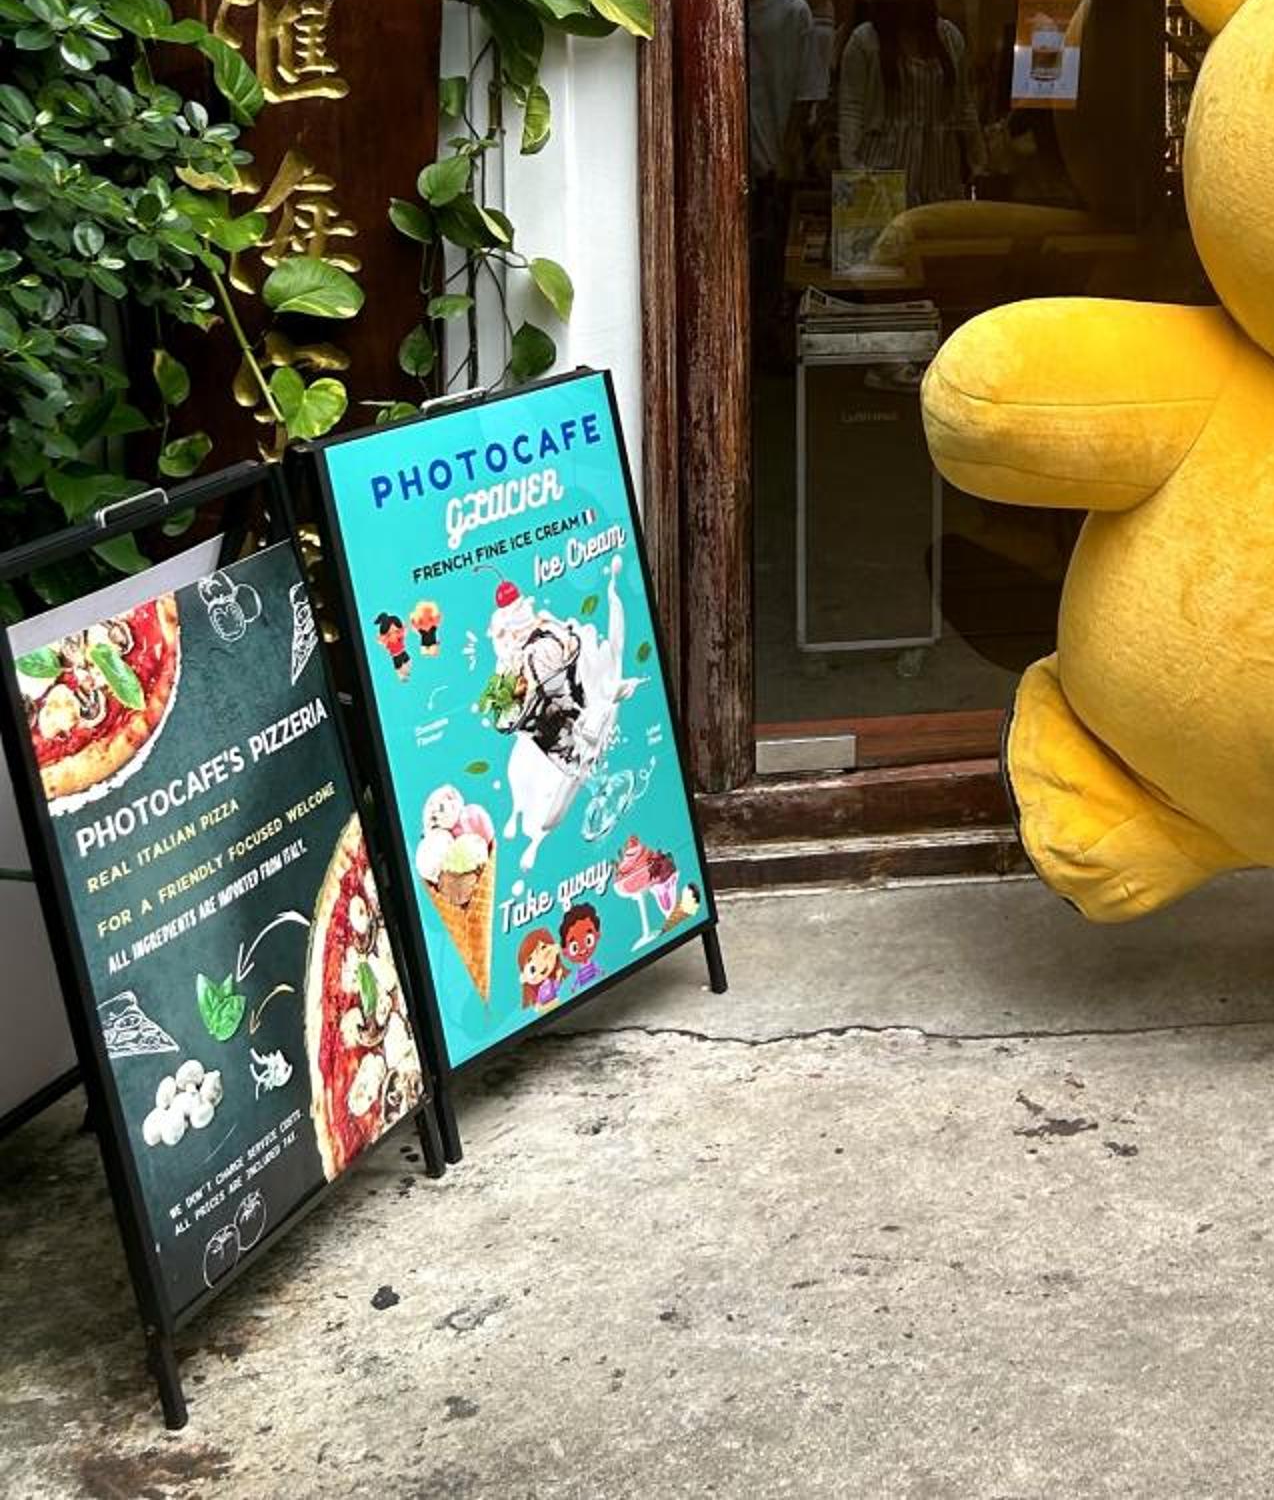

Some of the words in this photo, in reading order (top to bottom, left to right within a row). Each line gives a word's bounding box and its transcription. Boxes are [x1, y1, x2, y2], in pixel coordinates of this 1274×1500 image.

[370, 413, 601, 509] PHOTOCAFE
[412, 551, 474, 584] FRENCH
[475, 538, 508, 565] FINE
[509, 531, 533, 551] ICE
[534, 515, 582, 543] CREAM
[532, 553, 566, 588] Ice
[566, 523, 627, 570] Cream
[75, 745, 245, 857] PHOTOCAFE'S
[248, 698, 329, 764] PIZZERIA
[86, 861, 132, 894] REAL
[136, 823, 197, 867] ITALIAN
[200, 798, 241, 832] PIZZA
[97, 909, 133, 938] FOR
[140, 898, 153, 914] A
[158, 854, 224, 904] FRIENDLY
[228, 817, 283, 862] FOCUSED
[285, 781, 336, 824] WELCOME
[108, 952, 131, 975] ALL
[131, 908, 197, 960] INGREDIENTS
[198, 896, 218, 920] ARE
[217, 868, 260, 908] IMPORTED
[260, 853, 283, 881] FROM
[499, 889, 554, 934] Take
[557, 860, 614, 911] away
[175, 1219, 192, 1237] ALL
[195, 1190, 226, 1221] PRICES
[228, 1176, 243, 1194] ARE
